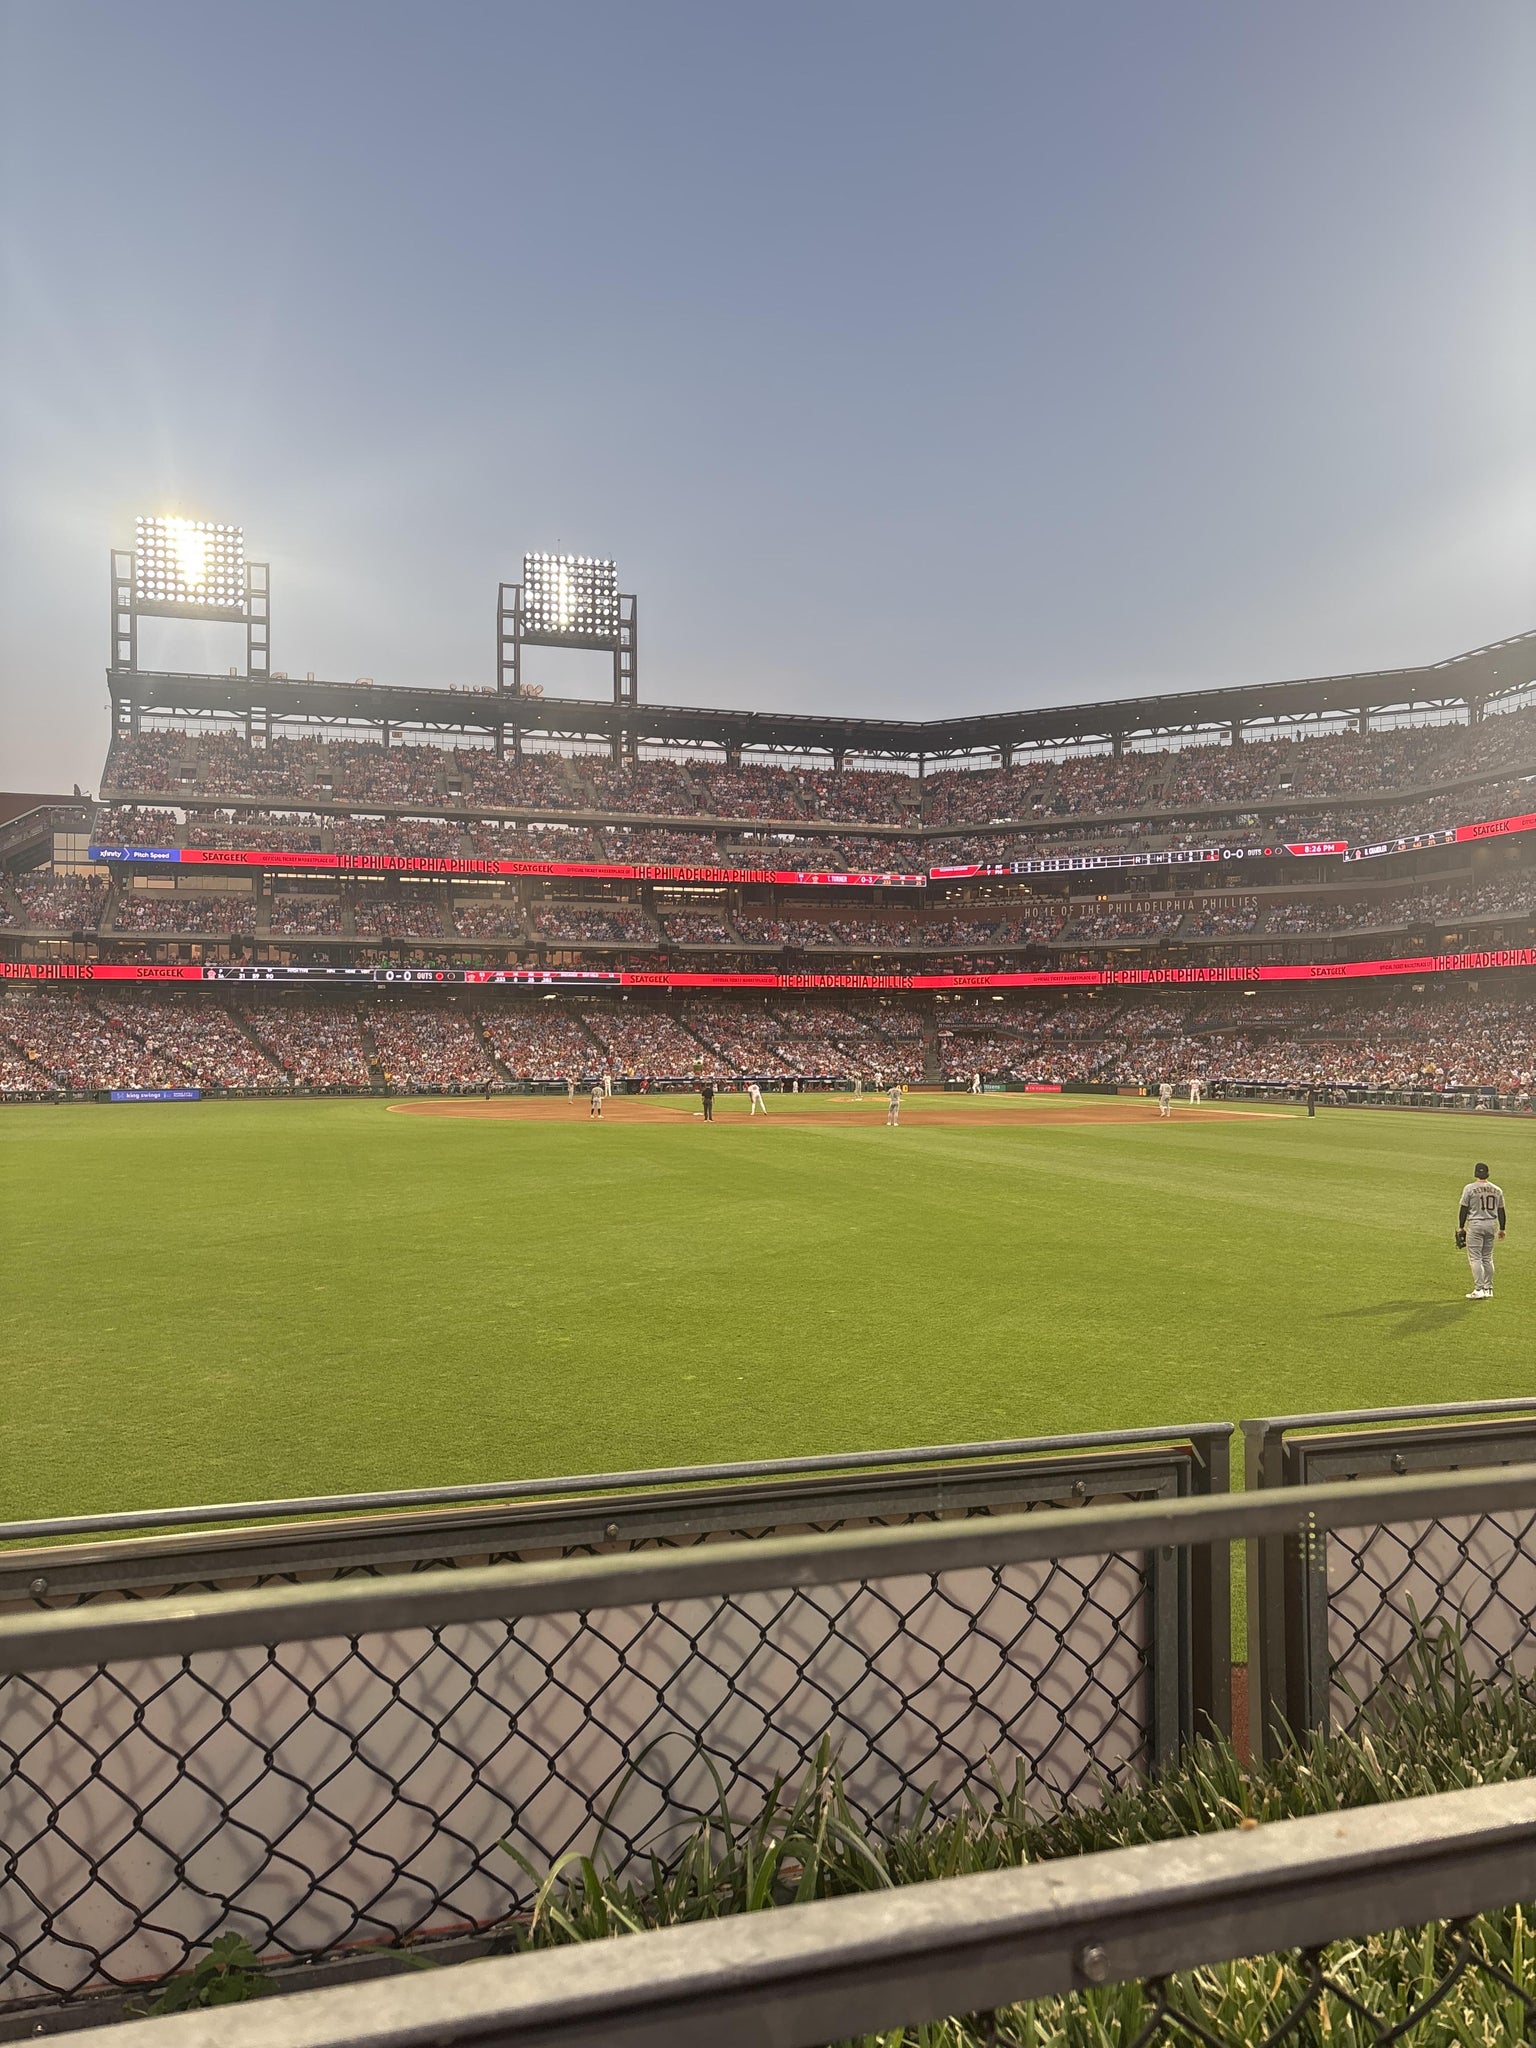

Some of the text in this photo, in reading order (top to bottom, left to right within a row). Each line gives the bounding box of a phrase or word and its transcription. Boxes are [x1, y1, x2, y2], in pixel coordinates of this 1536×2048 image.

[1473, 821, 1509, 837] SEATGEEK
[1247, 849, 1262, 857] OUTS
[1304, 844, 1335, 853] 8:26 PM
[100, 850, 122, 859] xfinity
[133, 851, 170, 861] Pitch Speed
[202, 852, 248, 863] SEATGEEK
[1178, 853, 1183, 861] E
[337, 855, 500, 873] THE PHILADELPHIA PHILLIES
[513, 863, 554, 873] SEATGEEK
[632, 867, 776, 883] THE PHILADELPHIA PHILLIES
[1062, 905, 1074, 917] OF
[1080, 904, 1101, 914] THE
[1108, 899, 1194, 914] PHILADELPHIA
[1202, 896, 1259, 910] PHILLIES
[1433, 956, 1450, 970] THE
[1452, 950, 1528, 969] PHILADELPHIA
[0, 963, 94, 979] PHIA PHILLIES
[136, 968, 184, 977] SEATGEEK
[417, 972, 433, 980] OUTS
[1098, 967, 1260, 984] THE PHILADELPHIA PHILLIES
[1310, 966, 1347, 977] SEATGEEK
[630, 975, 669, 984] SEATGEEK
[775, 975, 913, 988] THE PHILADELPHIA PHILLIES
[953, 976, 991, 986] SEATGEEK
[1480, 1195, 1496, 1211] 10
